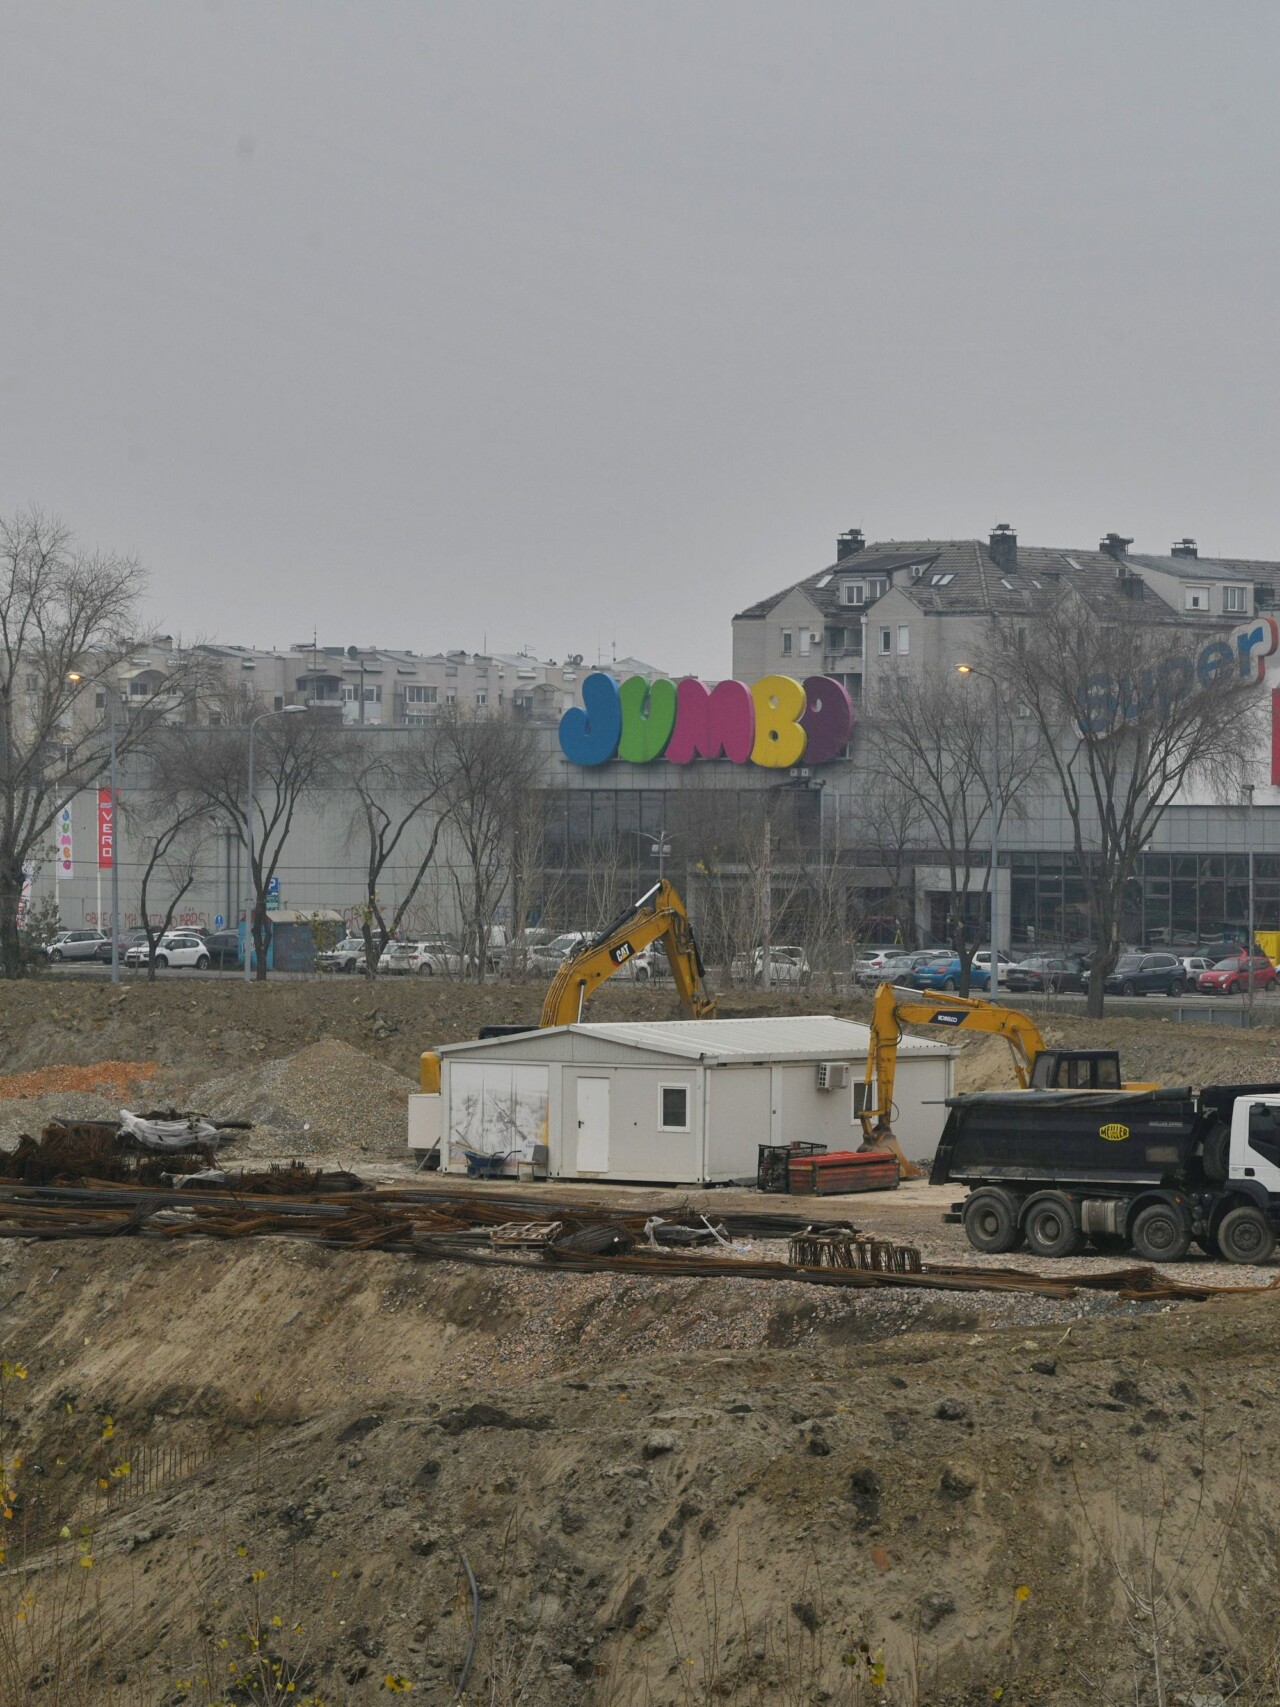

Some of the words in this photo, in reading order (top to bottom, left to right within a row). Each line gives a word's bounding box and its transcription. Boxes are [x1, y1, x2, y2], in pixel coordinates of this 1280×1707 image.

[559, 673, 855, 768] JUMBO
[101, 811, 112, 857] VERO
[616, 943, 630, 962] CAT
[938, 1015, 958, 1023] KOBELCO
[1101, 1125, 1128, 1139] MEILLER
